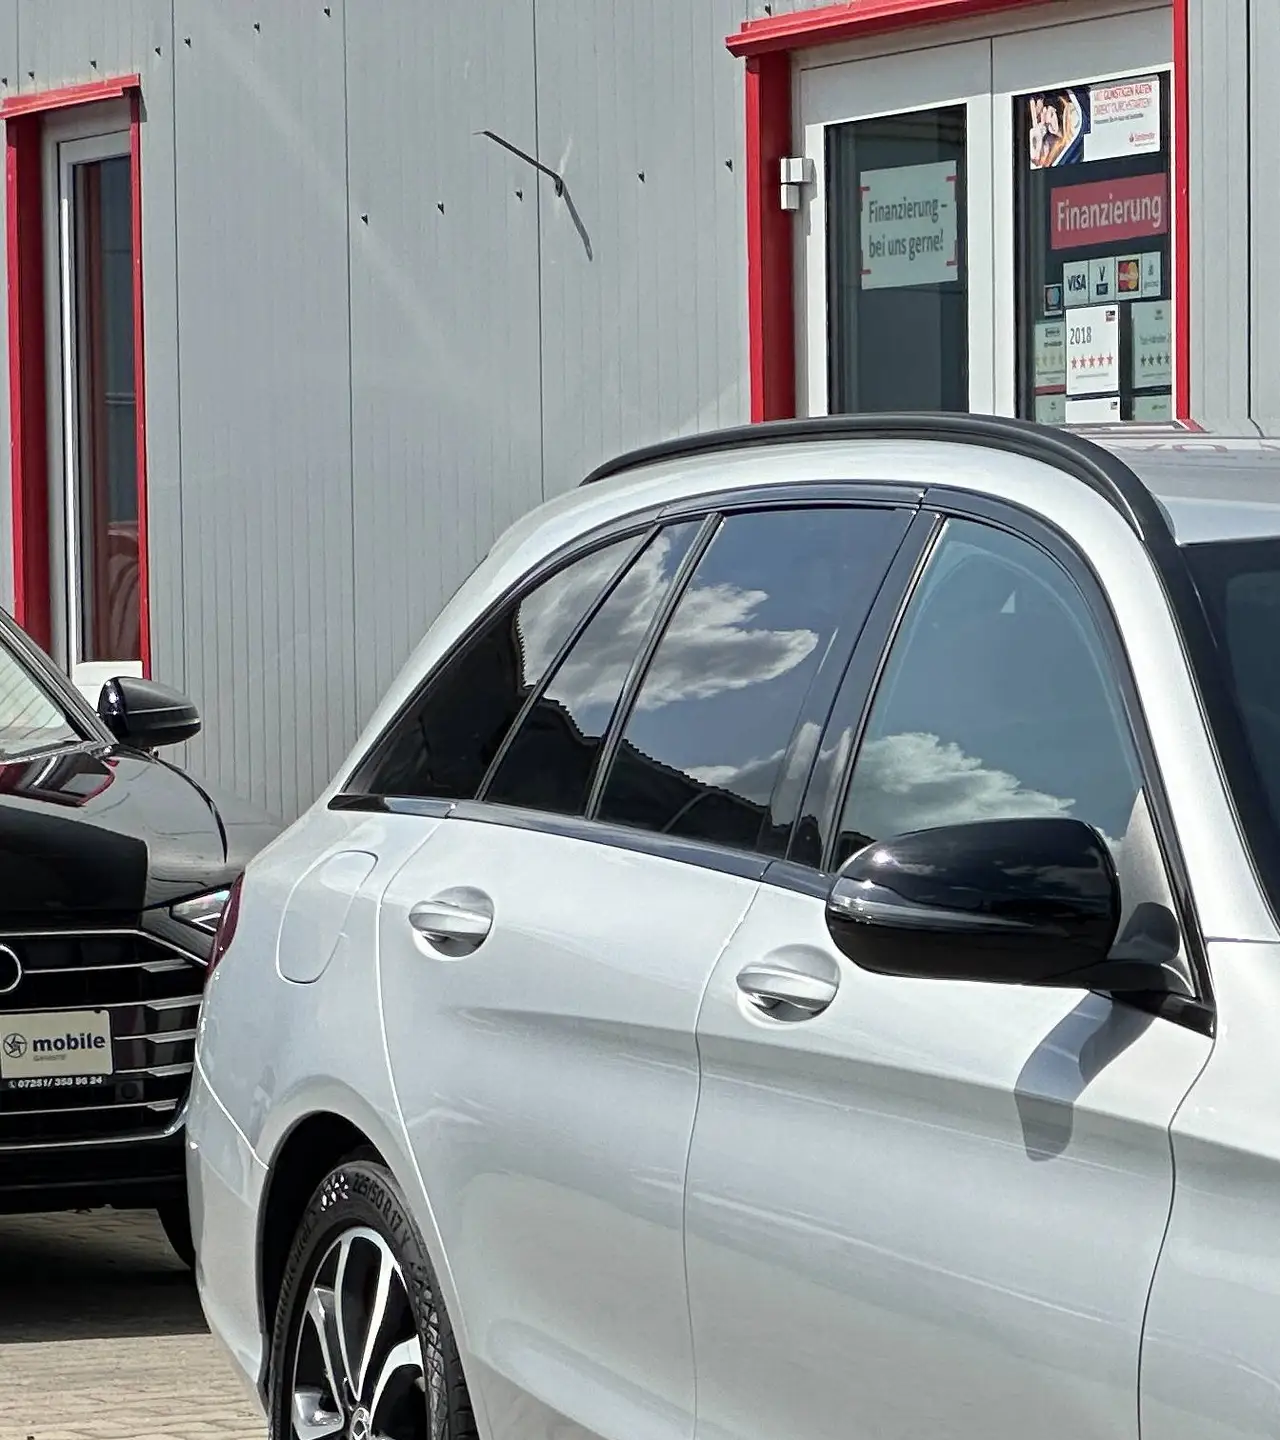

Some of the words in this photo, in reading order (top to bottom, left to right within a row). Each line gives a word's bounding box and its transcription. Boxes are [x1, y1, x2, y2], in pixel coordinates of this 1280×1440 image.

[869, 196, 939, 223] Finanzierung
[1057, 192, 1161, 232] Finanzierung
[869, 233, 886, 258] bei
[888, 237, 906, 256] uns
[908, 228, 944, 261] gerne!
[1067, 274, 1087, 292] VISA
[1069, 326, 1092, 345] 2018
[33, 1033, 106, 1052] mobile
